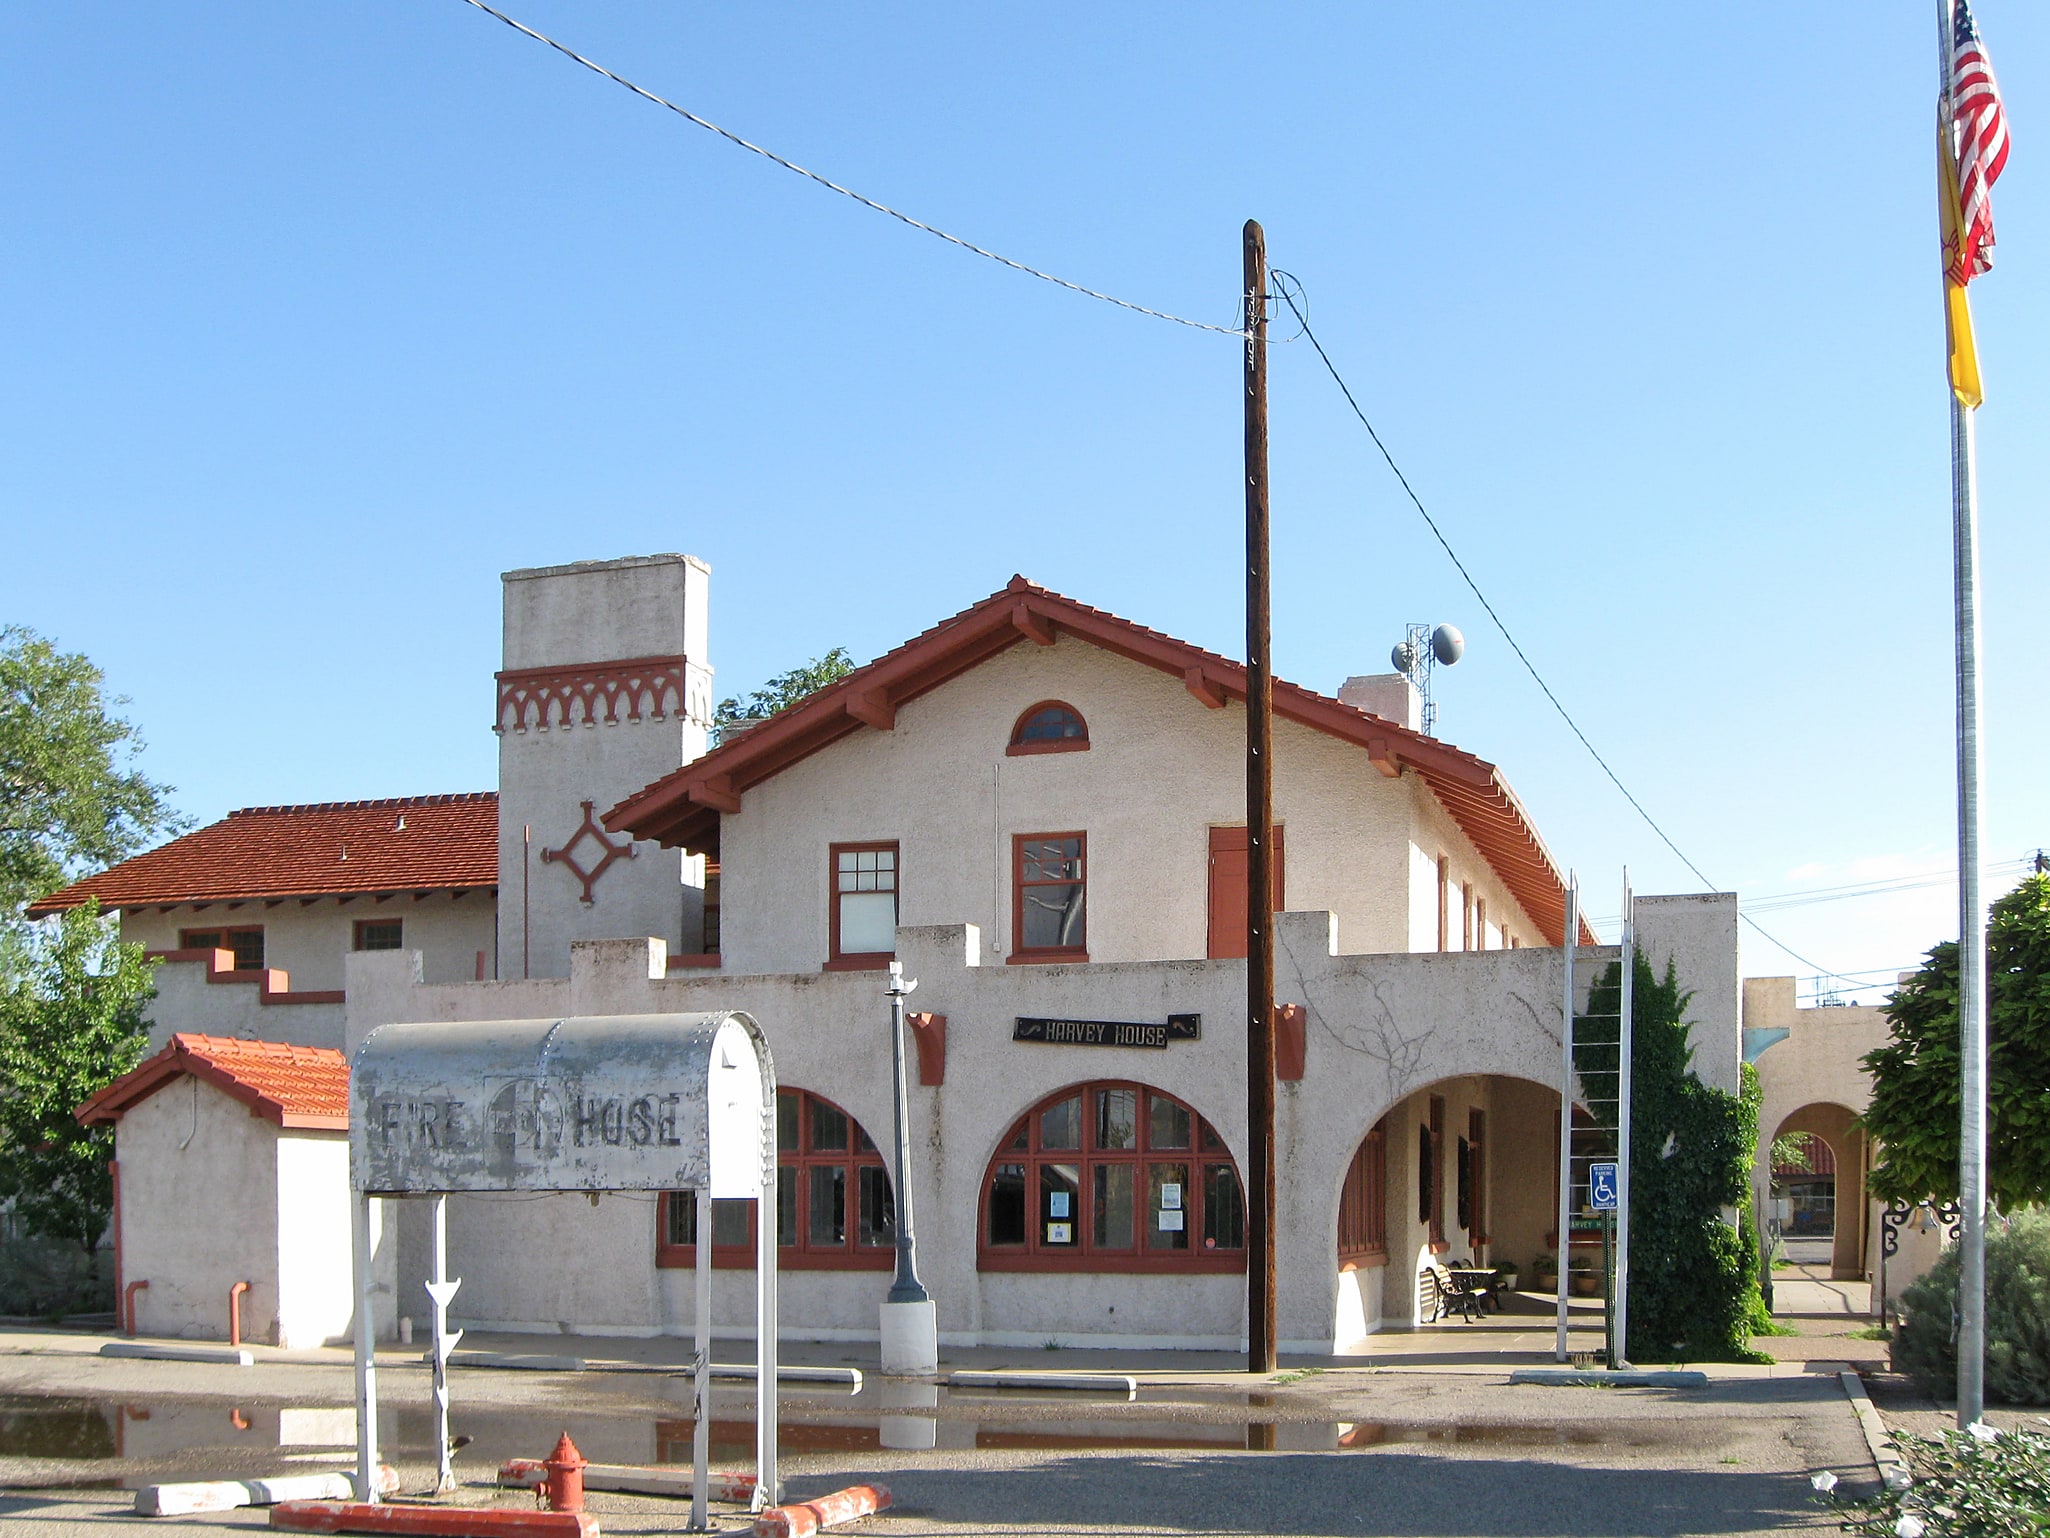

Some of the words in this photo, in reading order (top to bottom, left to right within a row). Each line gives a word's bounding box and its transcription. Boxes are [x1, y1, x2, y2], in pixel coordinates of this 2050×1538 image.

[1046, 1021, 1105, 1043] HARVEY
[1114, 1025, 1166, 1046] HOUSE
[380, 1102, 466, 1150] FIRE
[573, 1092, 681, 1148] HOSE
